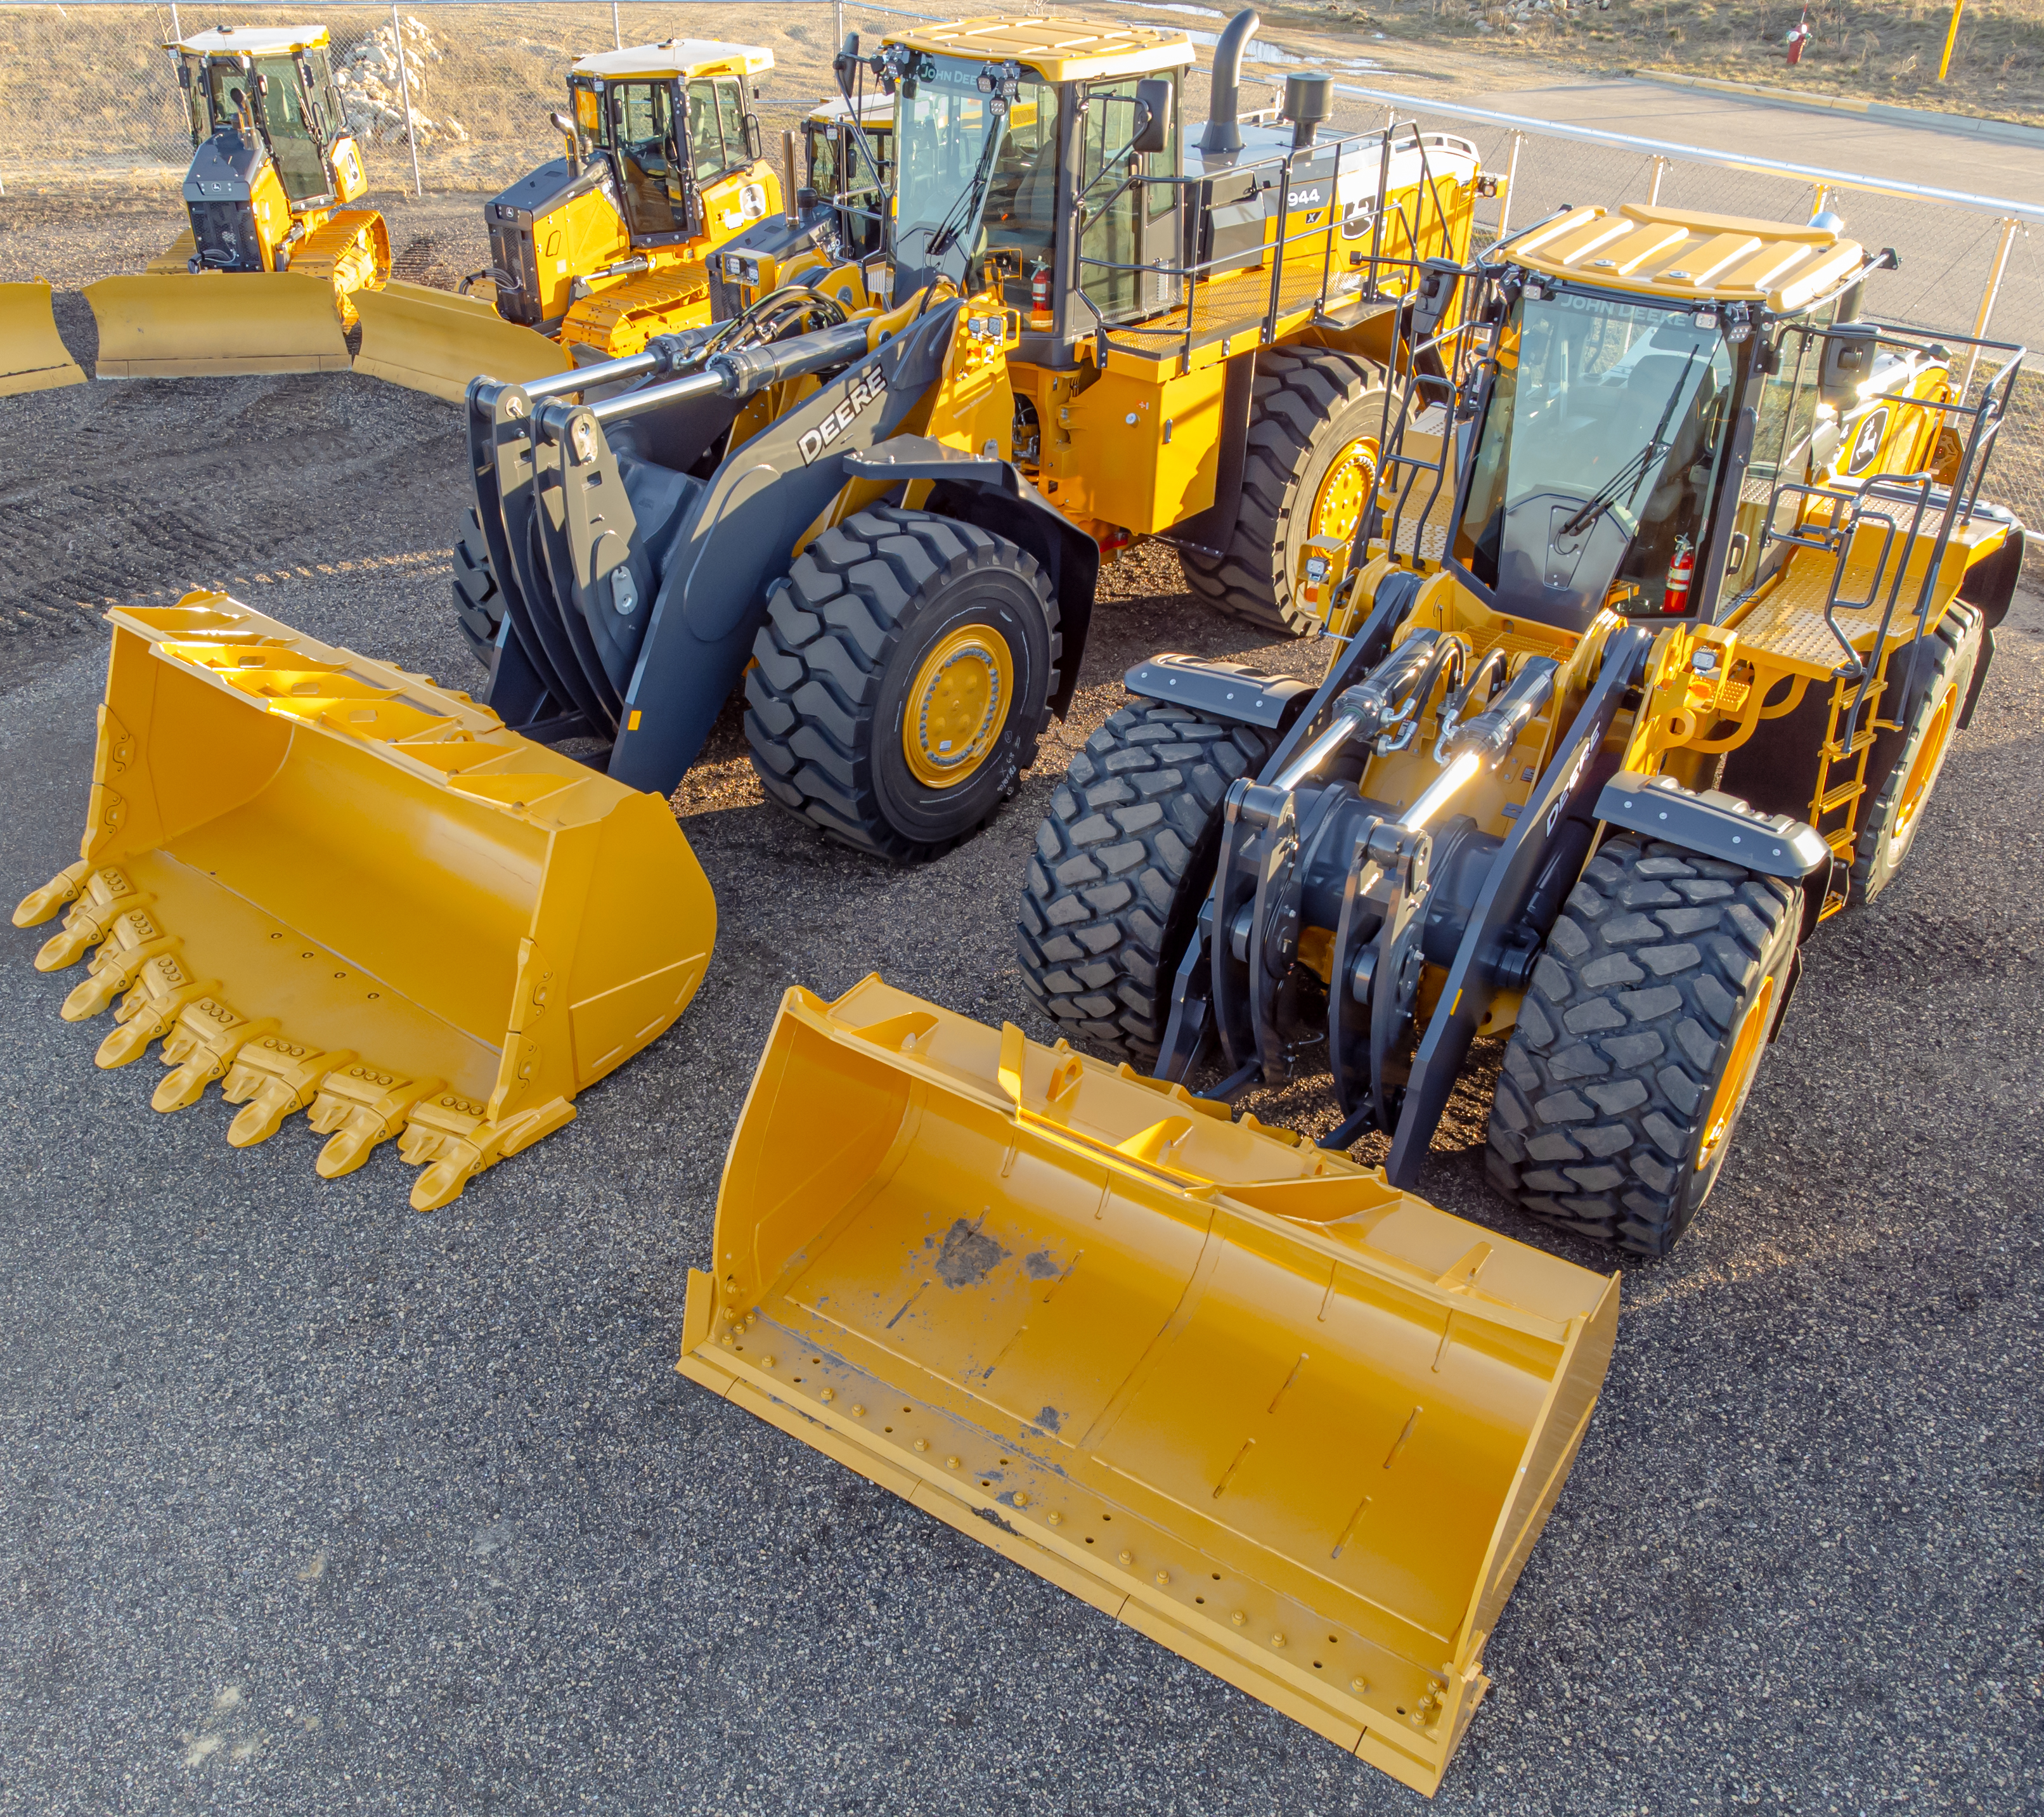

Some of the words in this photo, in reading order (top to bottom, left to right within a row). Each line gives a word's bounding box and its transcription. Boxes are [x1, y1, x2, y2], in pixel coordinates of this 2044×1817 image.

[921, 65, 952, 82] JOHN
[954, 70, 978, 86] DEE
[1288, 188, 1320, 207] 944
[827, 238, 841, 252] 450
[1560, 294, 1615, 315] JOHN
[1618, 303, 1686, 327] DEERE
[798, 364, 887, 467] DEERE
[1546, 720, 1600, 837] DEERE
